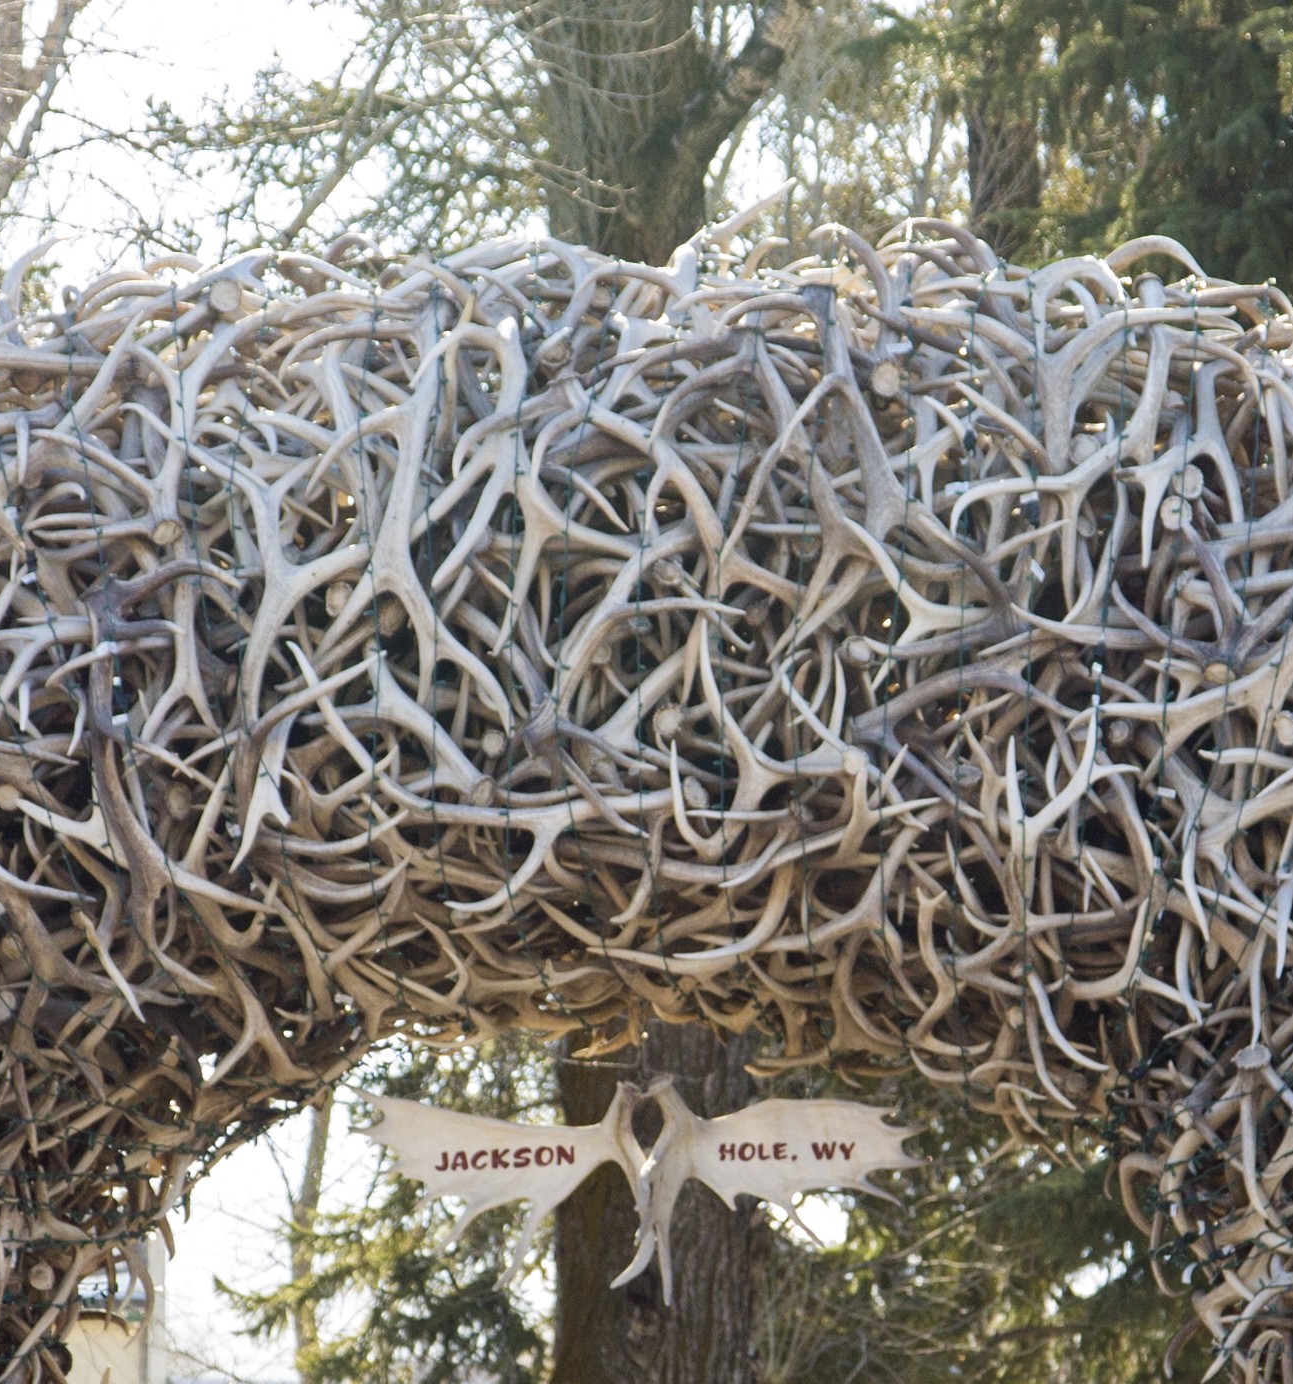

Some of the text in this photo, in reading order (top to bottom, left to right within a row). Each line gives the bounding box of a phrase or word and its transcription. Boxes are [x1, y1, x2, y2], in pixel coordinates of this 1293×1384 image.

[435, 1141, 856, 1171] JACKSON HOLE, WY
